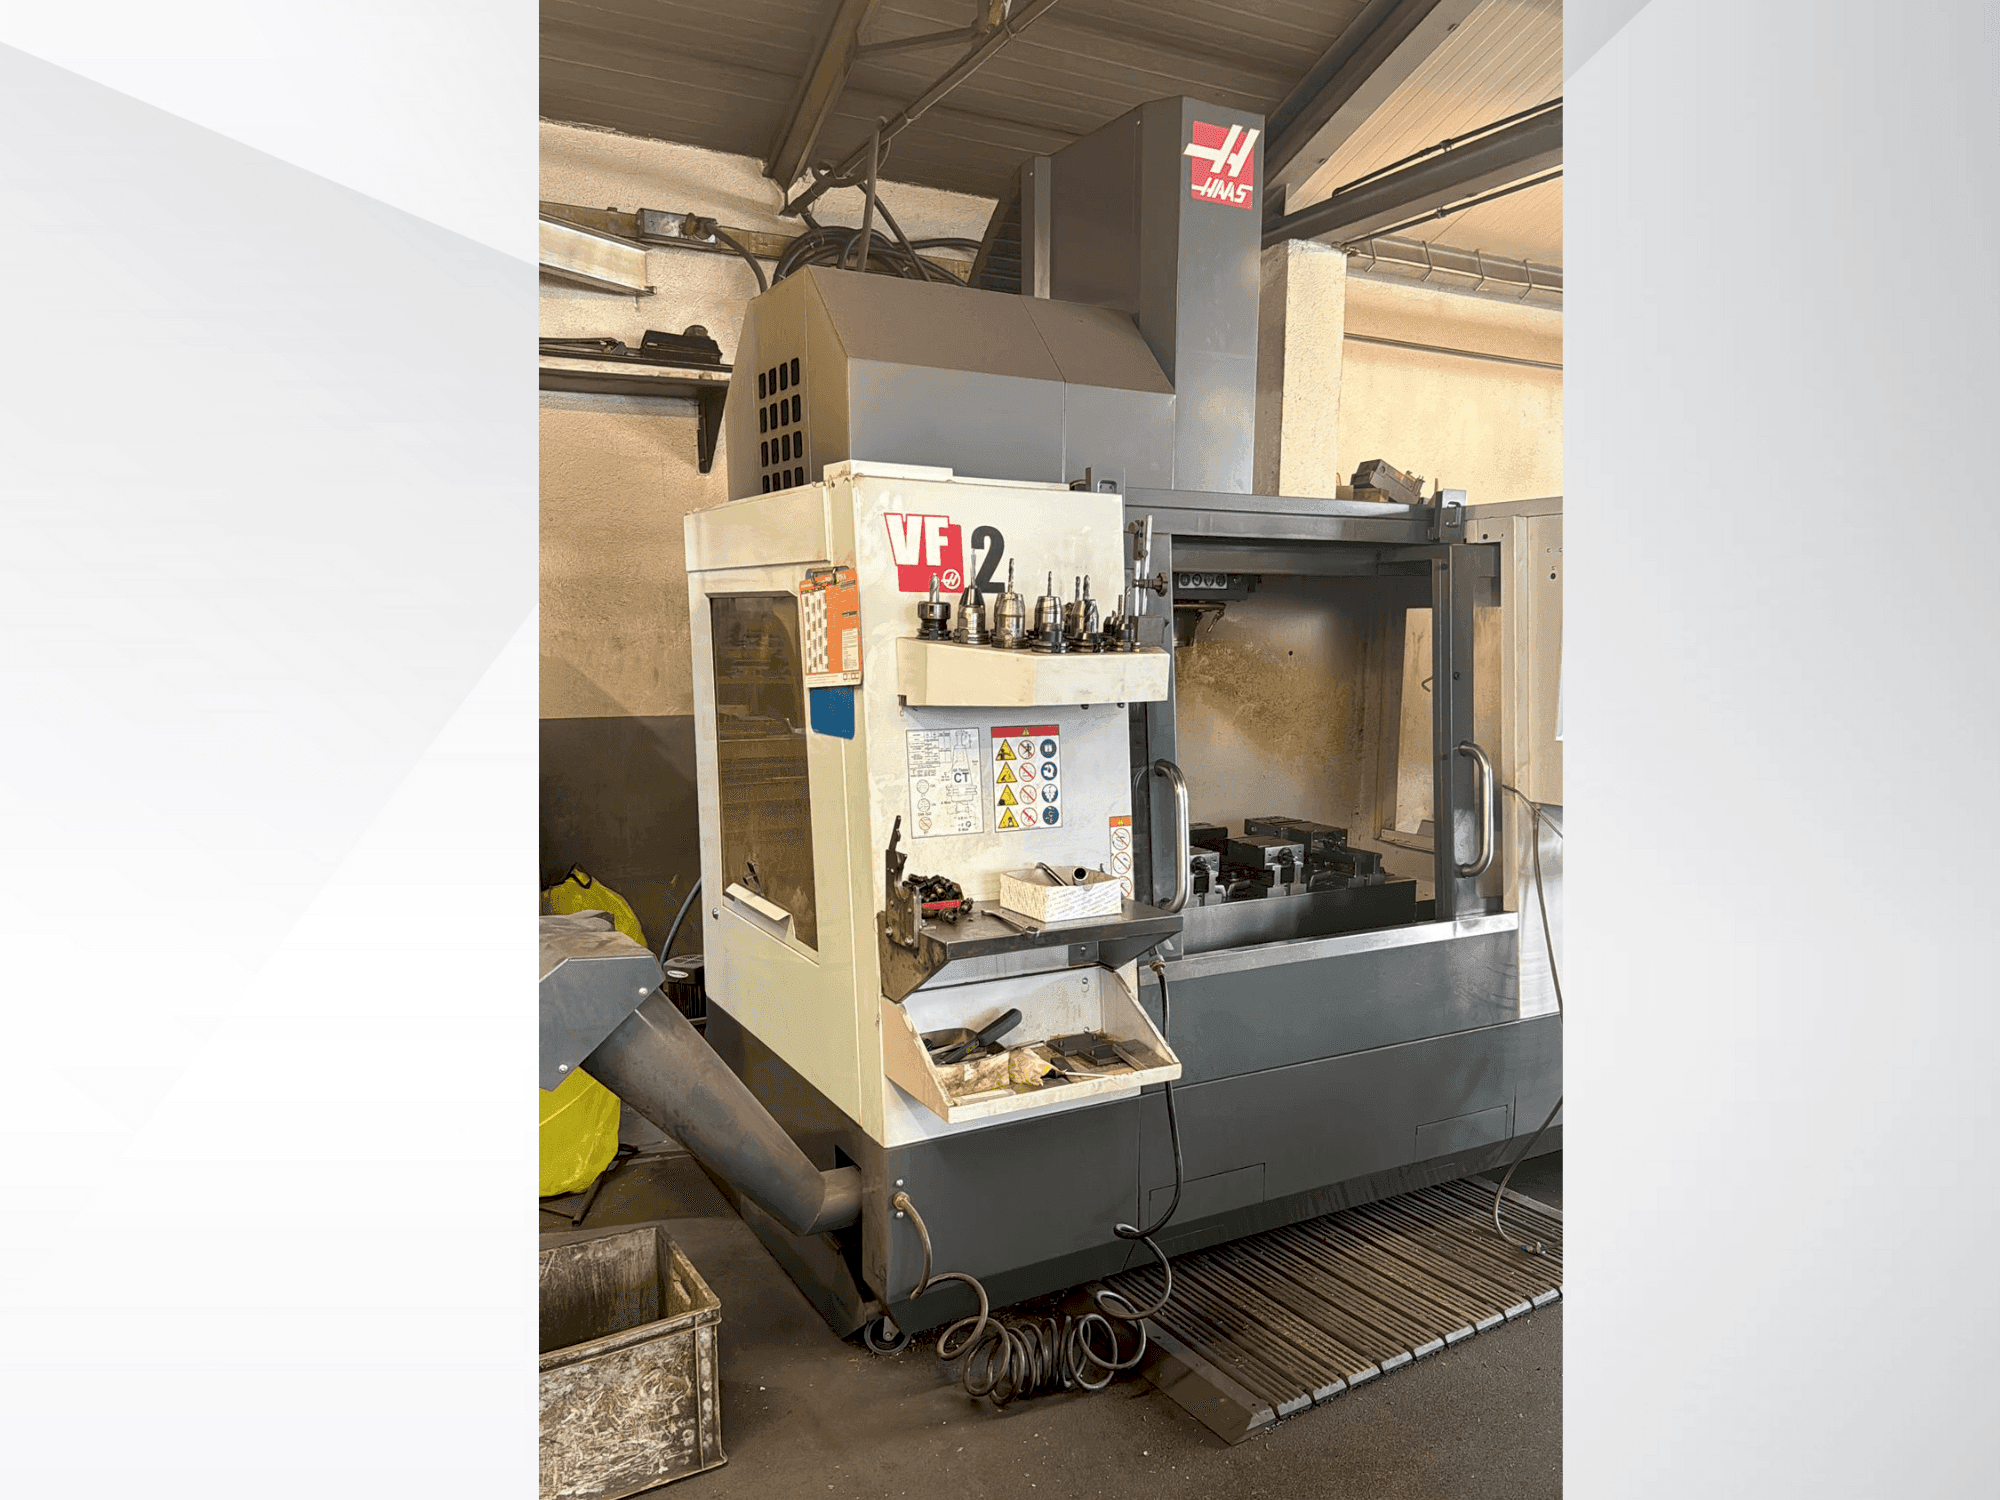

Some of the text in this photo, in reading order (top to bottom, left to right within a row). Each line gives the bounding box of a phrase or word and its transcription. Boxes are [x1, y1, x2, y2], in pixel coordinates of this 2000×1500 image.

[1191, 177, 1253, 204] HAAS
[884, 512, 1006, 593] VF 2
[953, 772, 970, 783] CT
